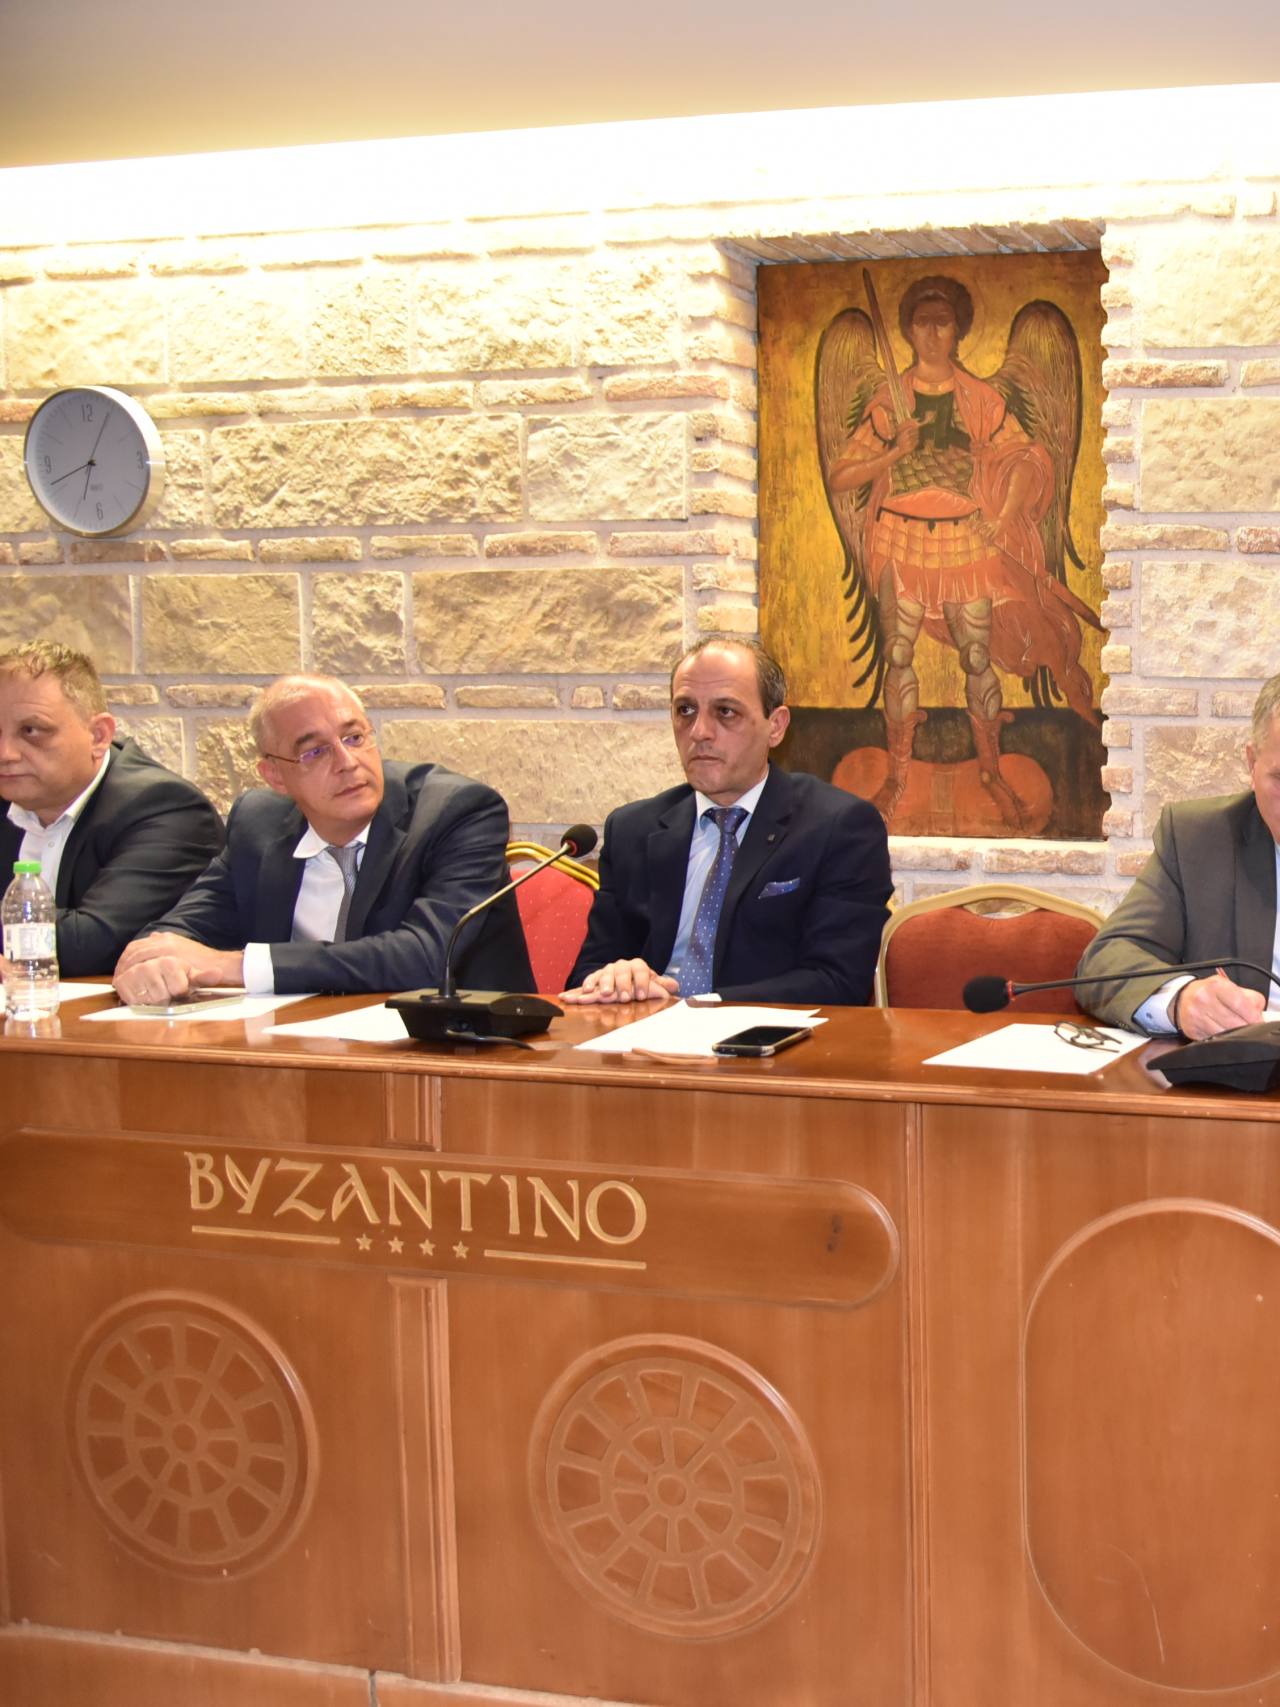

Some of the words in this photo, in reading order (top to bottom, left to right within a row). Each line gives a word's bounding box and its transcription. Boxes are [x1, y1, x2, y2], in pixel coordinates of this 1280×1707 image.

[80, 404, 94, 422] 12
[43, 455, 52, 474] 9
[136, 451, 144, 470] 3
[95, 502, 104, 521] 6
[184, 1151, 647, 1245] BYZANTINO
